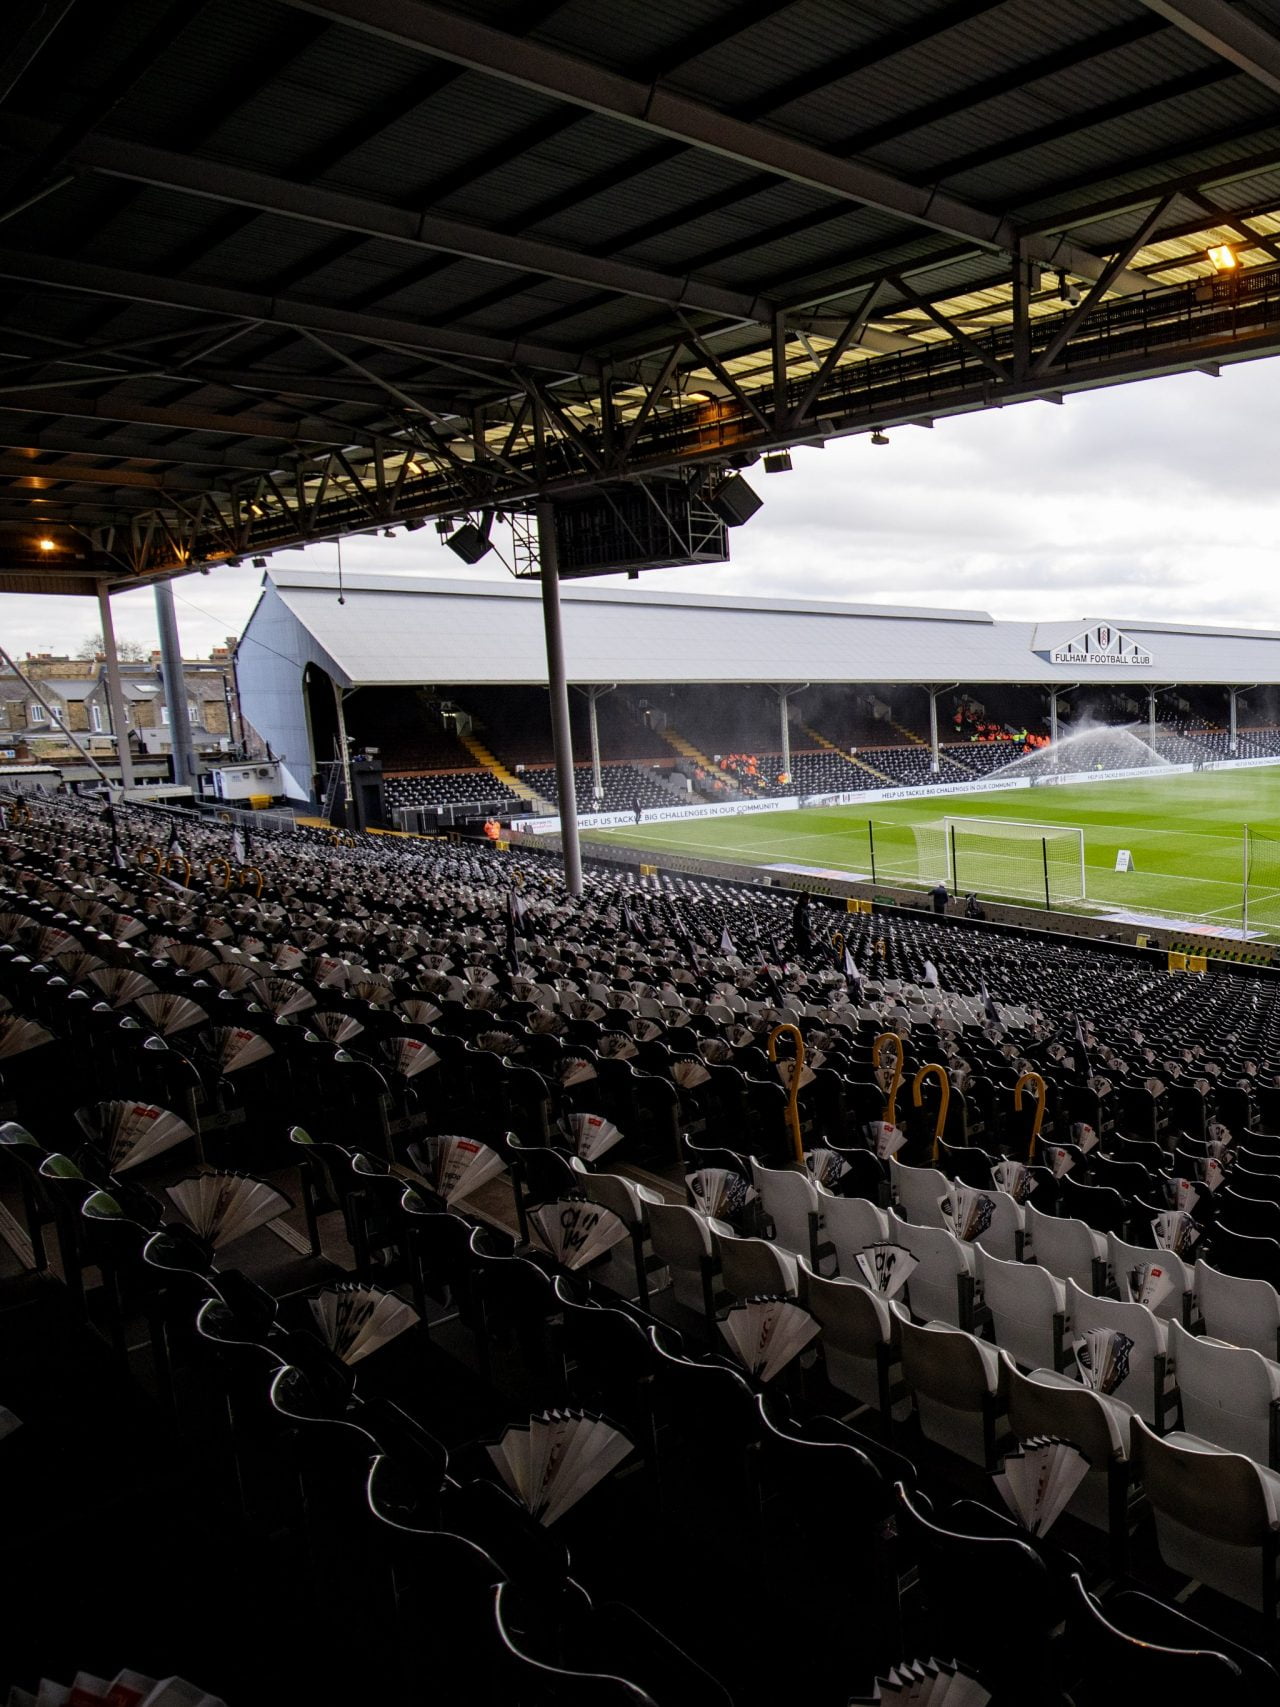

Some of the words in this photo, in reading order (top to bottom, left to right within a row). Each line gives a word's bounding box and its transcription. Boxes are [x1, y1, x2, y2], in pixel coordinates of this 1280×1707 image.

[1055, 653, 1087, 663] FULHAM
[1090, 654, 1128, 664] FOOTBALL
[1131, 655, 1150, 664] CLUB
[936, 785, 968, 794] CHALLENGES
[988, 781, 1017, 789] COMMUNITY
[577, 818, 598, 827] HELP
[600, 817, 611, 825] US
[613, 814, 642, 824] TACKE
[644, 813, 658, 821] BIG
[660, 808, 708, 820] CHALLENGES
[709, 807, 718, 815] IN
[719, 806, 736, 815] OUR
[736, 802, 779, 813] COMMUNITY
